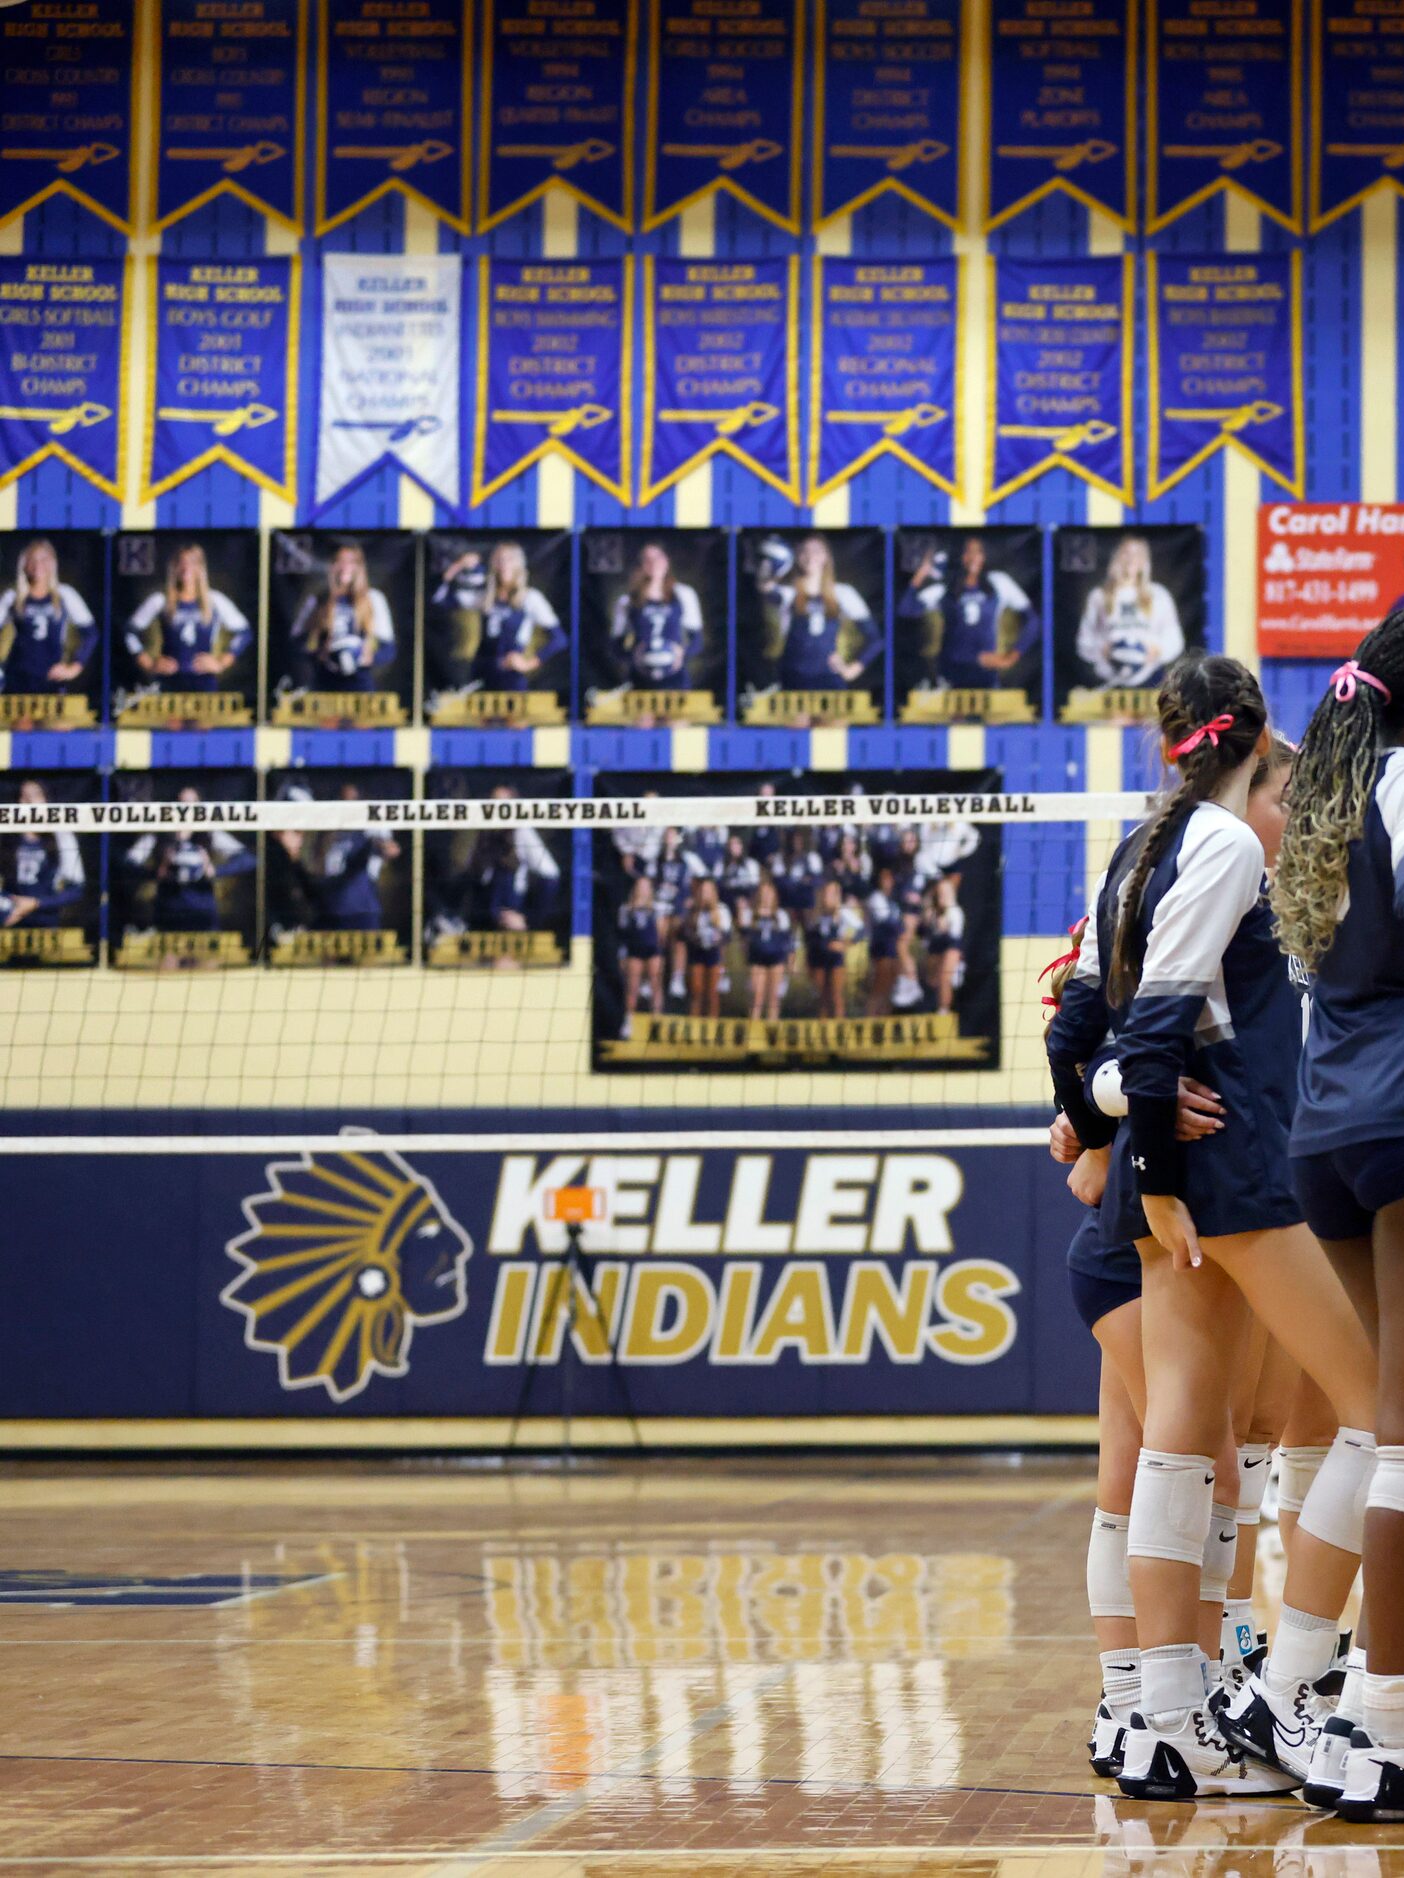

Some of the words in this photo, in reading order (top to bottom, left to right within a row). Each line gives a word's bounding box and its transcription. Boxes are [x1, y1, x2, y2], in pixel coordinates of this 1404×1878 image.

[26, 266, 93, 281] KELLER
[190, 267, 259, 282] KELLER
[1189, 266, 1257, 281] KELLER
[0, 284, 44, 300] HIGH
[50, 285, 118, 300] SCHOOL
[165, 285, 209, 300] HIGH
[214, 286, 283, 302] SCHOOL
[1214, 284, 1284, 301] SCHOOL
[178, 356, 262, 373] DISTRICT
[22, 378, 87, 396] CHAMPS
[177, 379, 260, 397] CHAMPS
[509, 380, 595, 398] CHAMPS
[676, 378, 763, 396] CHAMPS
[845, 380, 931, 397] CHAMPS
[1182, 378, 1265, 396] CHAMPS
[1016, 395, 1099, 414] CHAMPS
[1268, 506, 1349, 535] Carol
[93, 805, 259, 824] VOLLEYBALL
[367, 803, 468, 823] KELLER
[482, 801, 646, 822] VOLLEYBALL
[755, 798, 857, 818] KELLER
[869, 795, 1036, 816] VOLLEYBALL
[648, 1019, 743, 1046] KELLER
[766, 1018, 938, 1047] VOLLEYBALL
[487, 1154, 964, 1256] KELLER
[484, 1261, 1021, 1366] INDIANS
